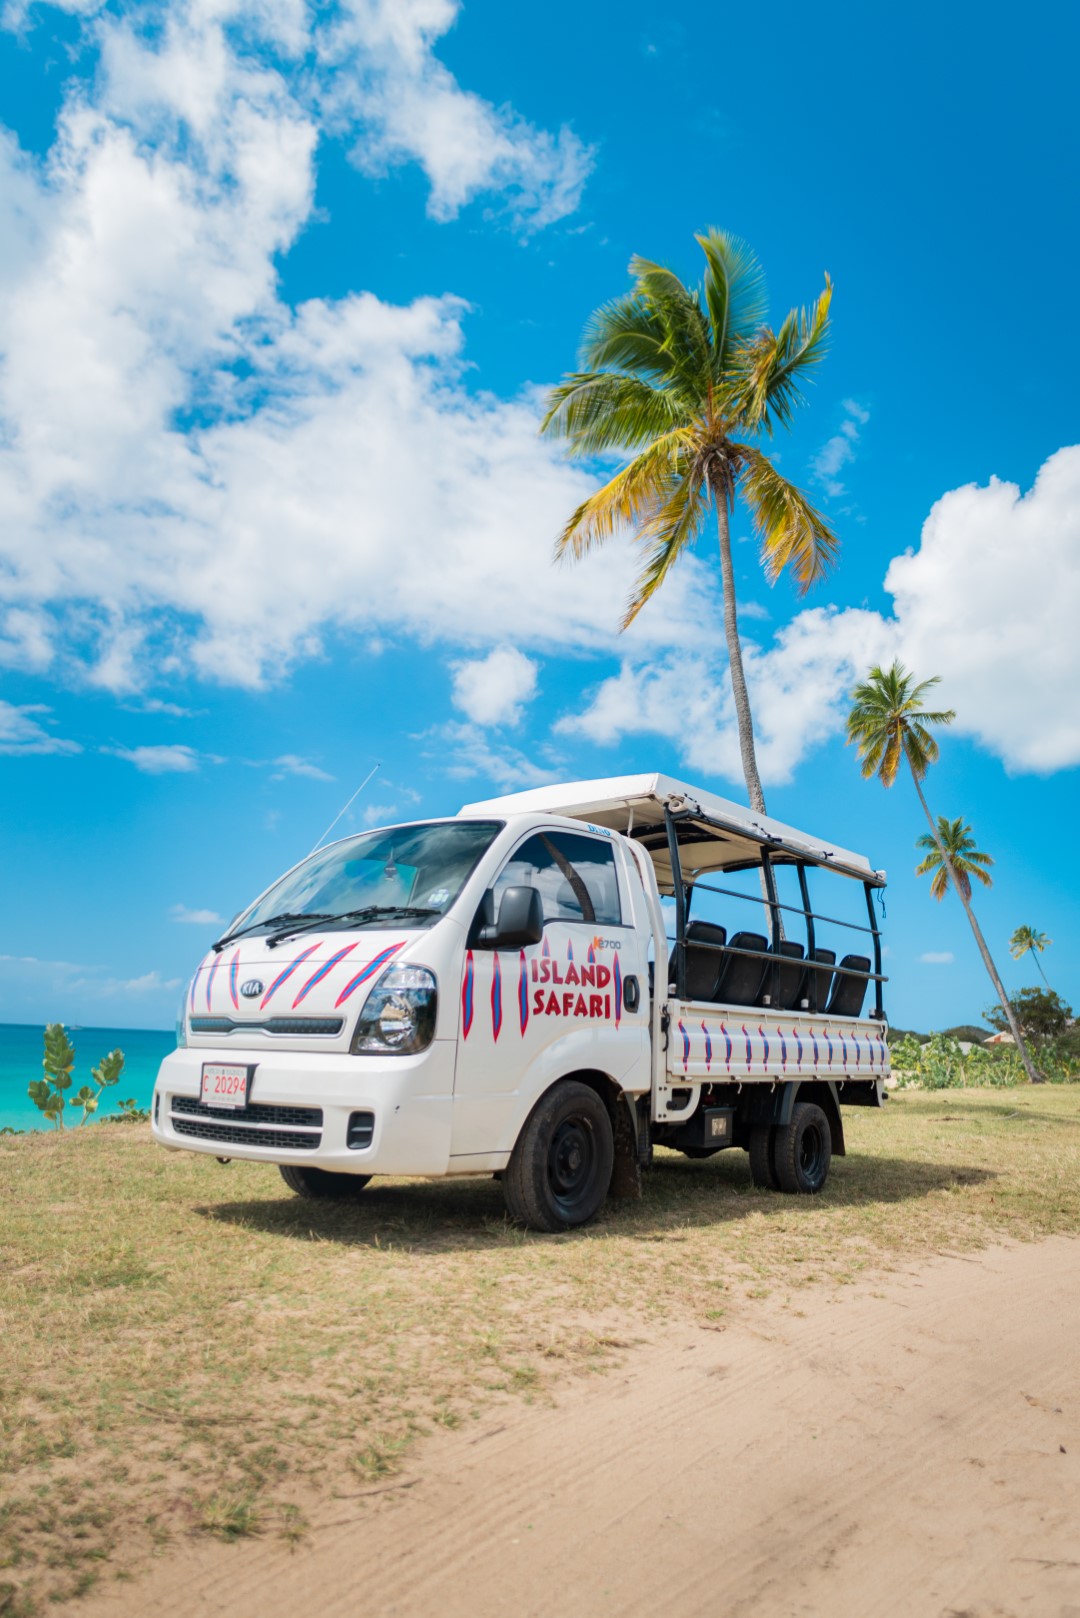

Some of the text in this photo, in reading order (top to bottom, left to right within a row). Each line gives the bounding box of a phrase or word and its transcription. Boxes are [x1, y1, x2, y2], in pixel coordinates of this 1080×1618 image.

[531, 959, 610, 989] ISLAND
[242, 982, 259, 995] KIA
[533, 989, 610, 1019] SAFARI
[203, 1075, 246, 1095] C 20294
